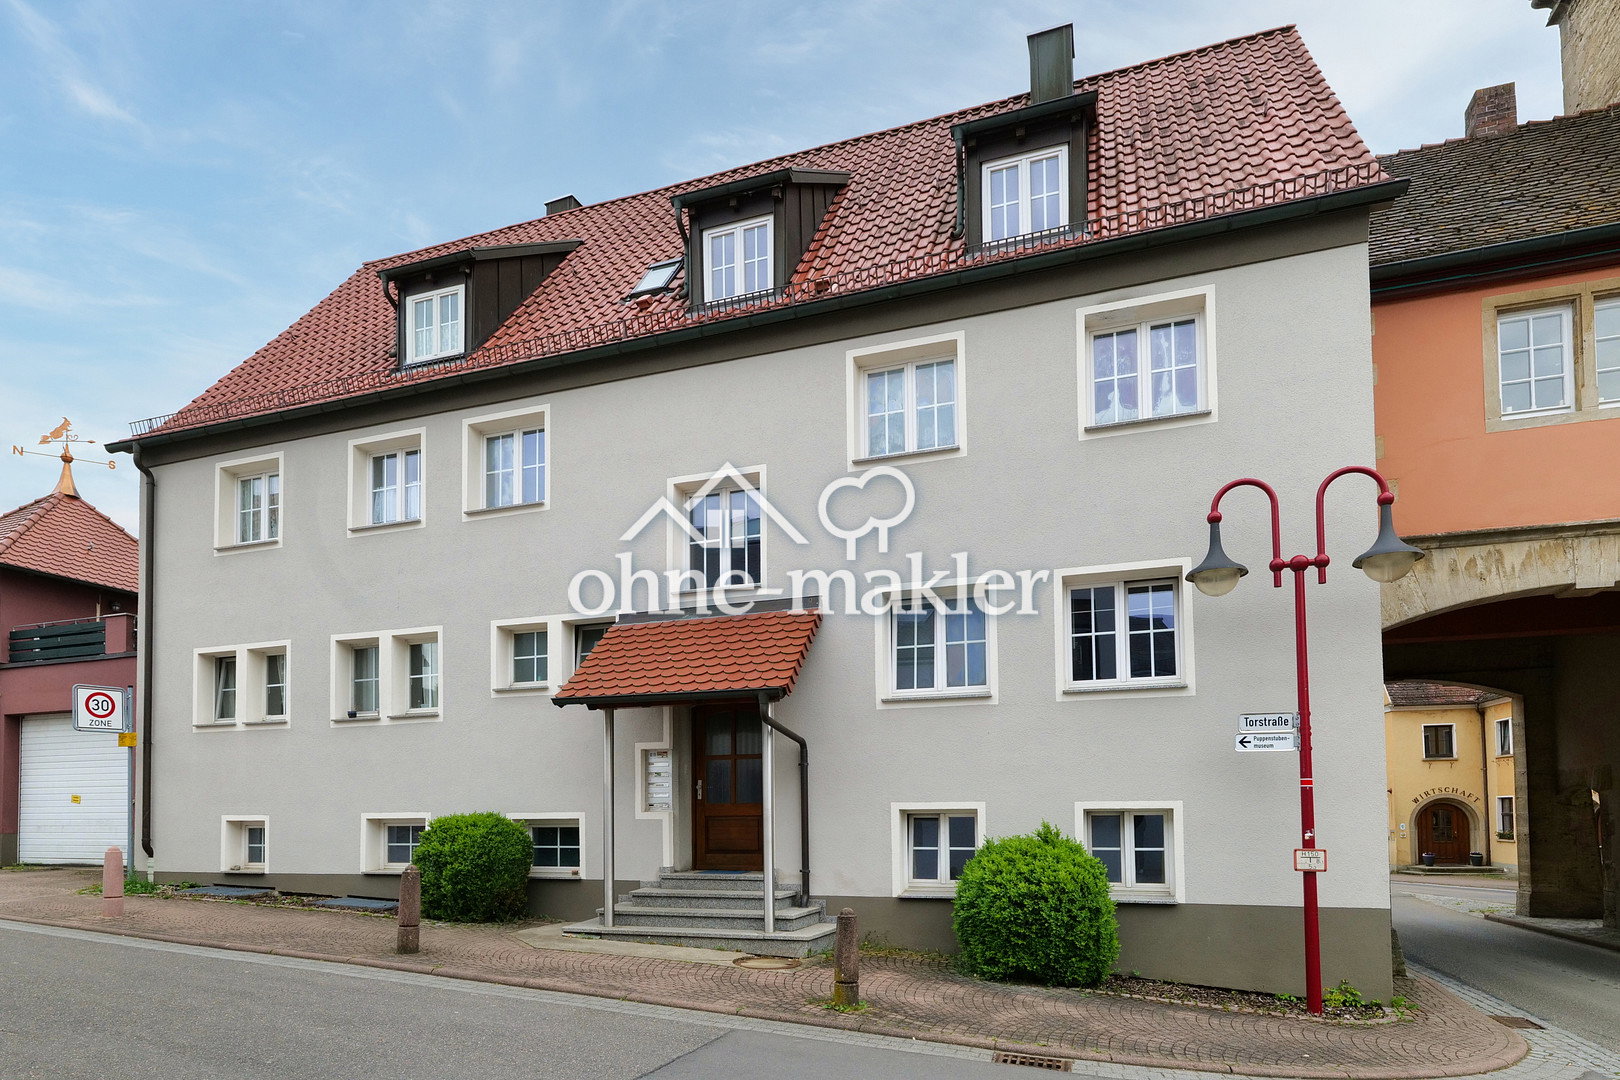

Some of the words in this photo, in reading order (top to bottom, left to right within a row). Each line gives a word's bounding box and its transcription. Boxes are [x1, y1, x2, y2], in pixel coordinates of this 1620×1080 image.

[91, 698, 110, 712] 30
[88, 719, 113, 728] ZONE
[1243, 715, 1290, 728] Torstraße
[1253, 735, 1291, 743] Puppenstuben-
[1411, 786, 1481, 805] WIRTSCHAFT
